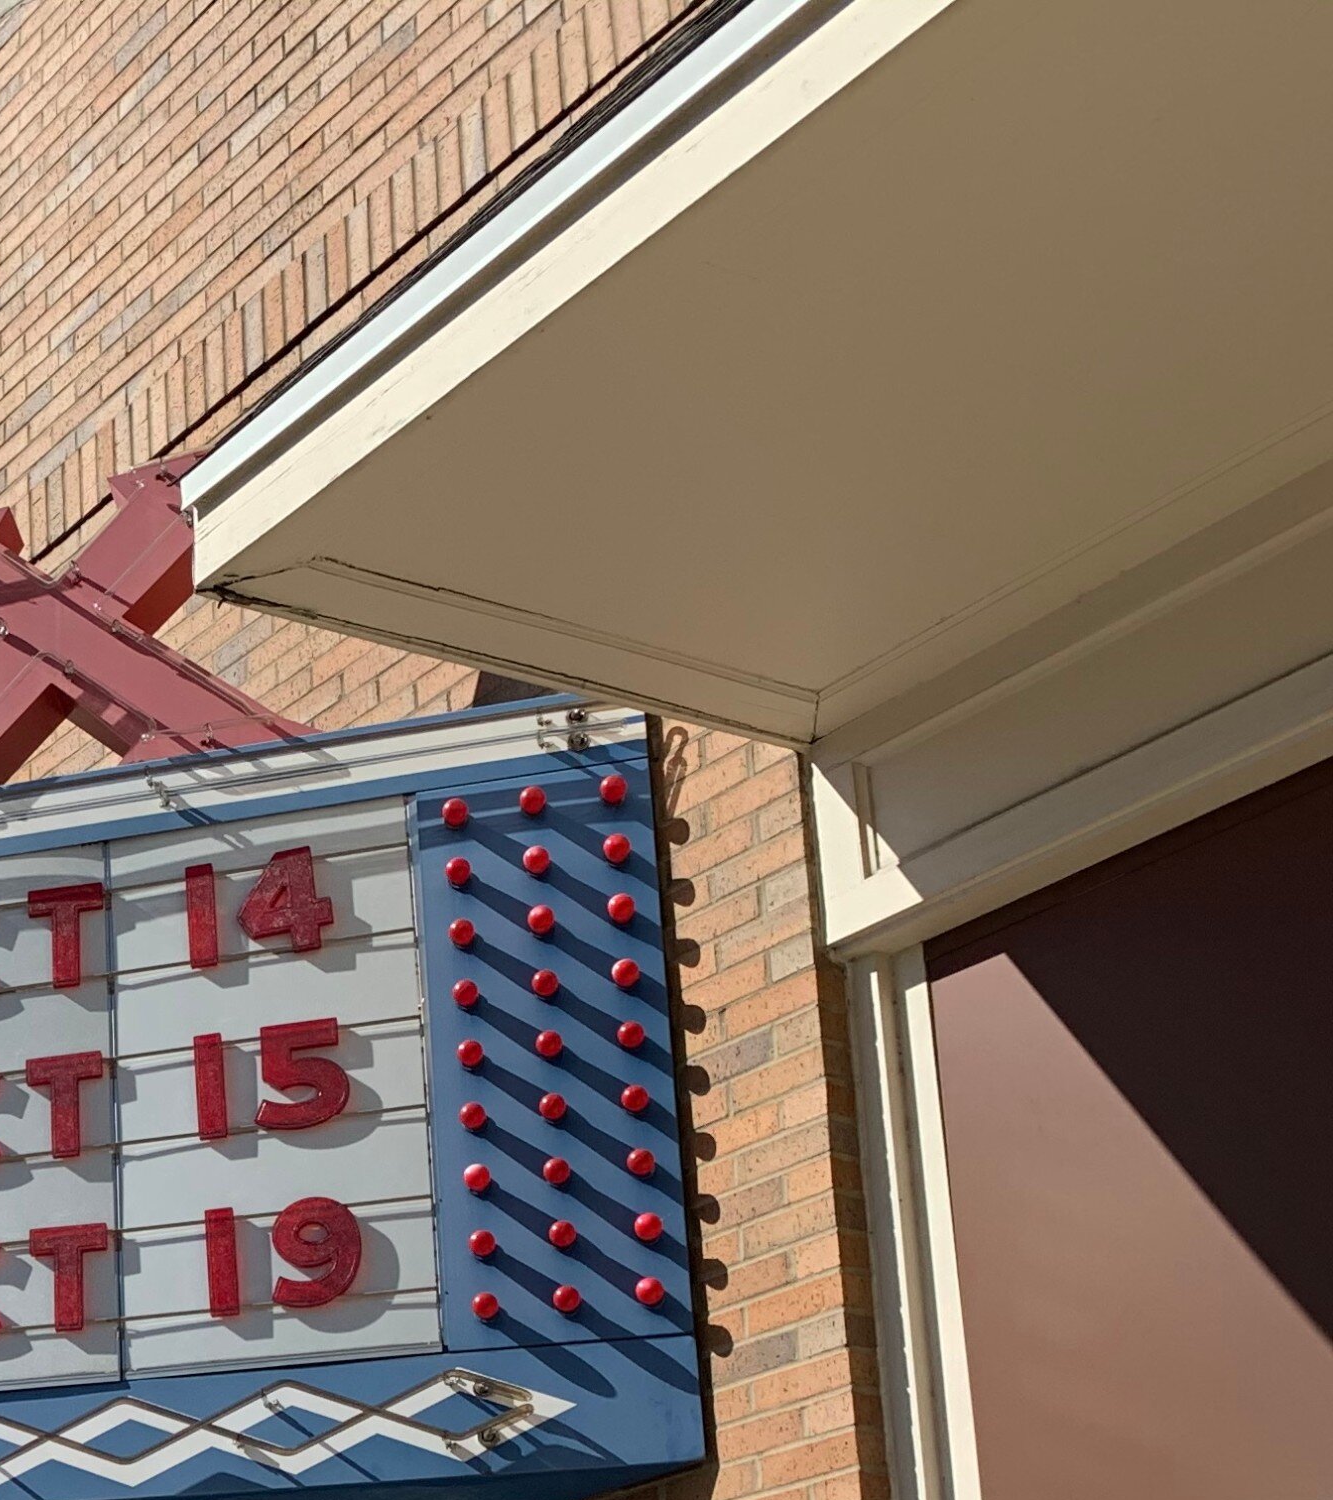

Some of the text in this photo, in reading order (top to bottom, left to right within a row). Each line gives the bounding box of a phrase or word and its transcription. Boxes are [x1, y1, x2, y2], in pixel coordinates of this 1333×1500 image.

[184, 846, 335, 969] 14
[193, 1017, 351, 1140] 15
[204, 1196, 362, 1318] 19
